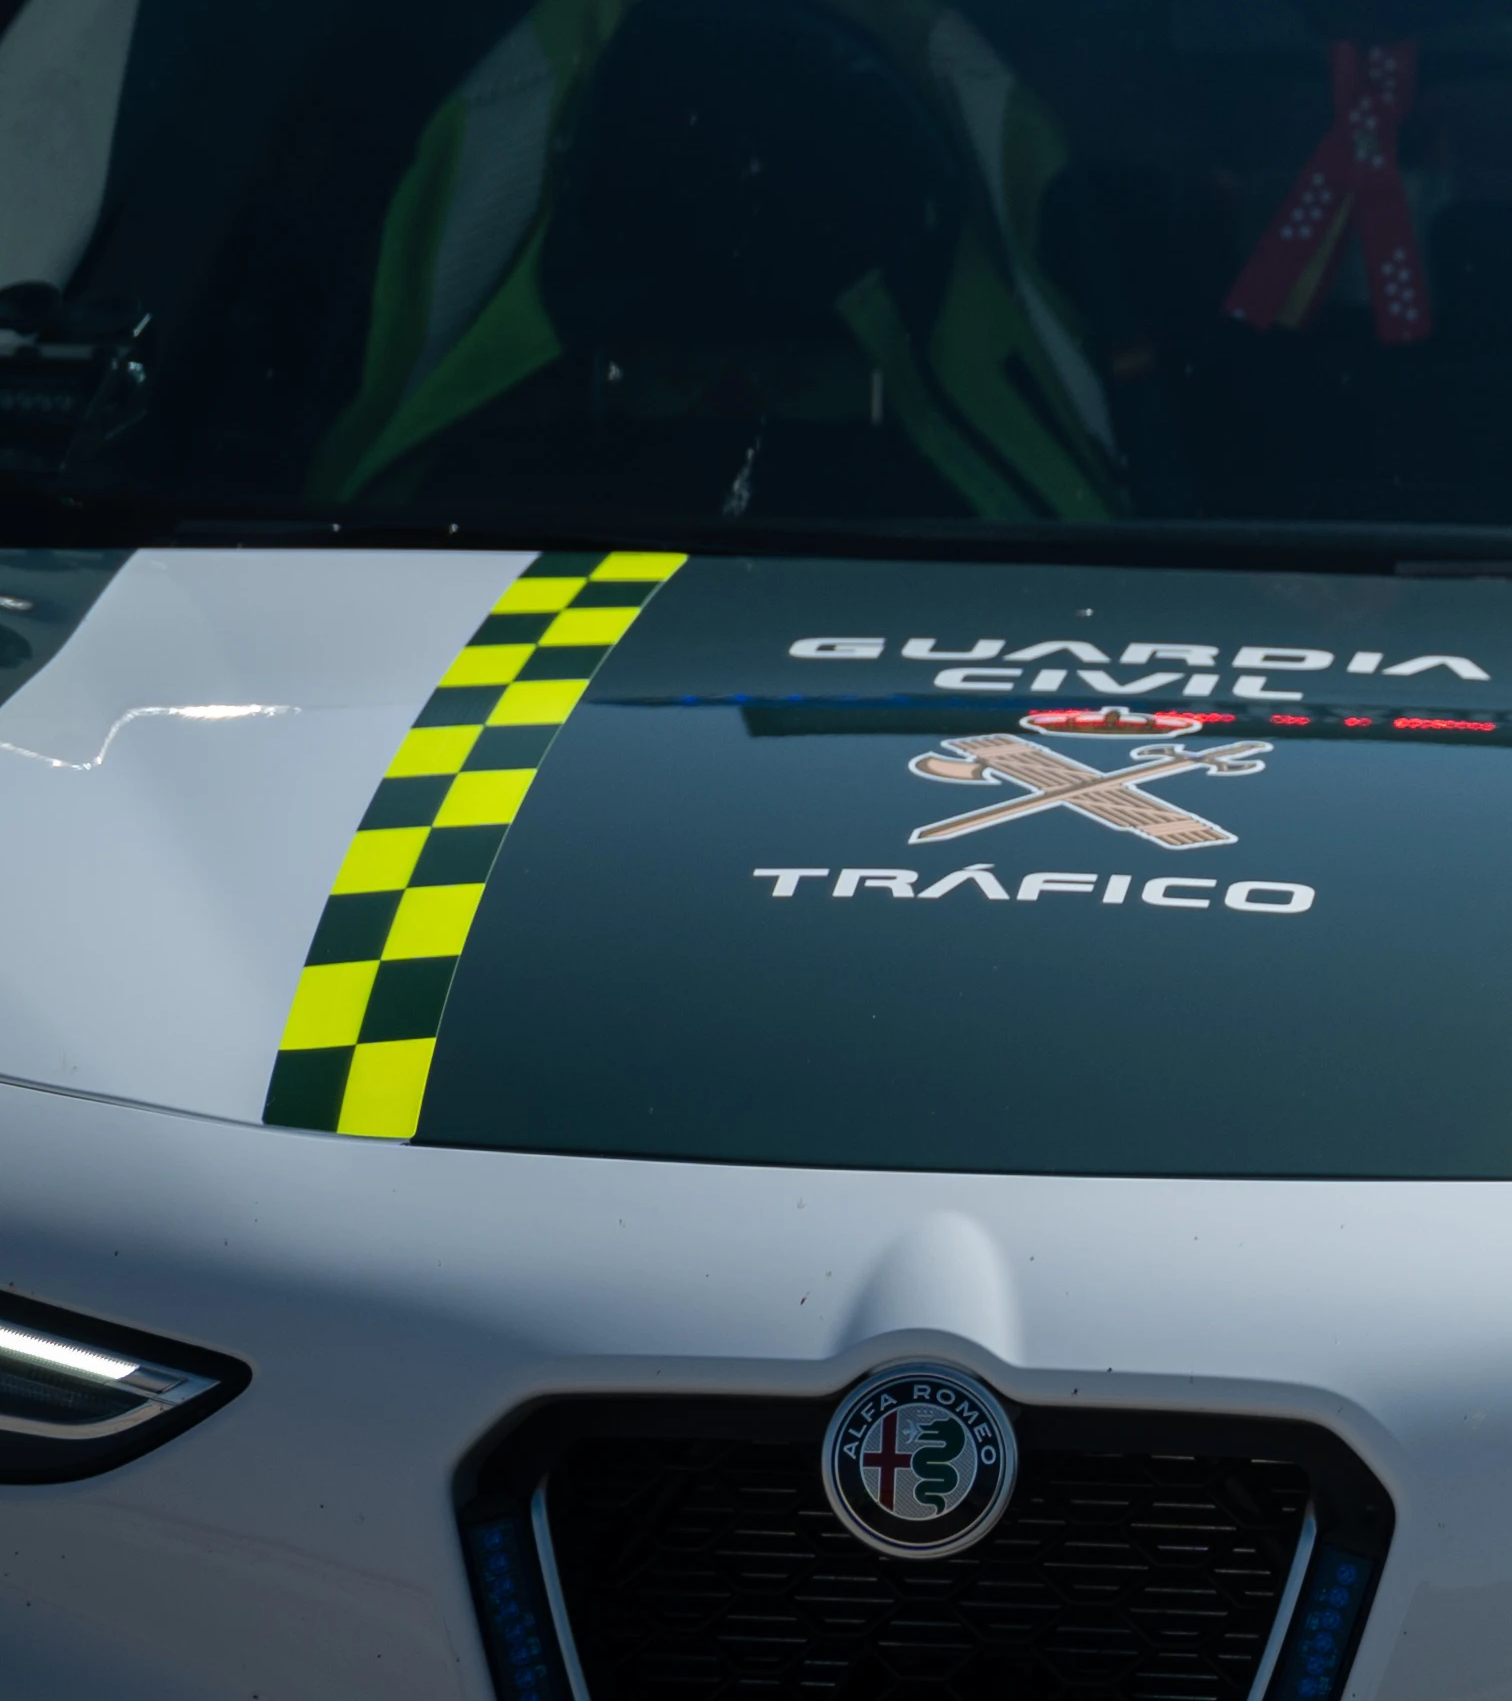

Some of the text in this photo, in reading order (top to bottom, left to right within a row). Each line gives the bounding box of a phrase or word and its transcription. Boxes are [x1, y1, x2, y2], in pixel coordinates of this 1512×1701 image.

[787, 636, 1492, 681] GUARDIA
[932, 666, 1304, 701] CIVIL
[752, 863, 1317, 914] TRÁFICO
[842, 1384, 997, 1466] ALFA ROMEO
